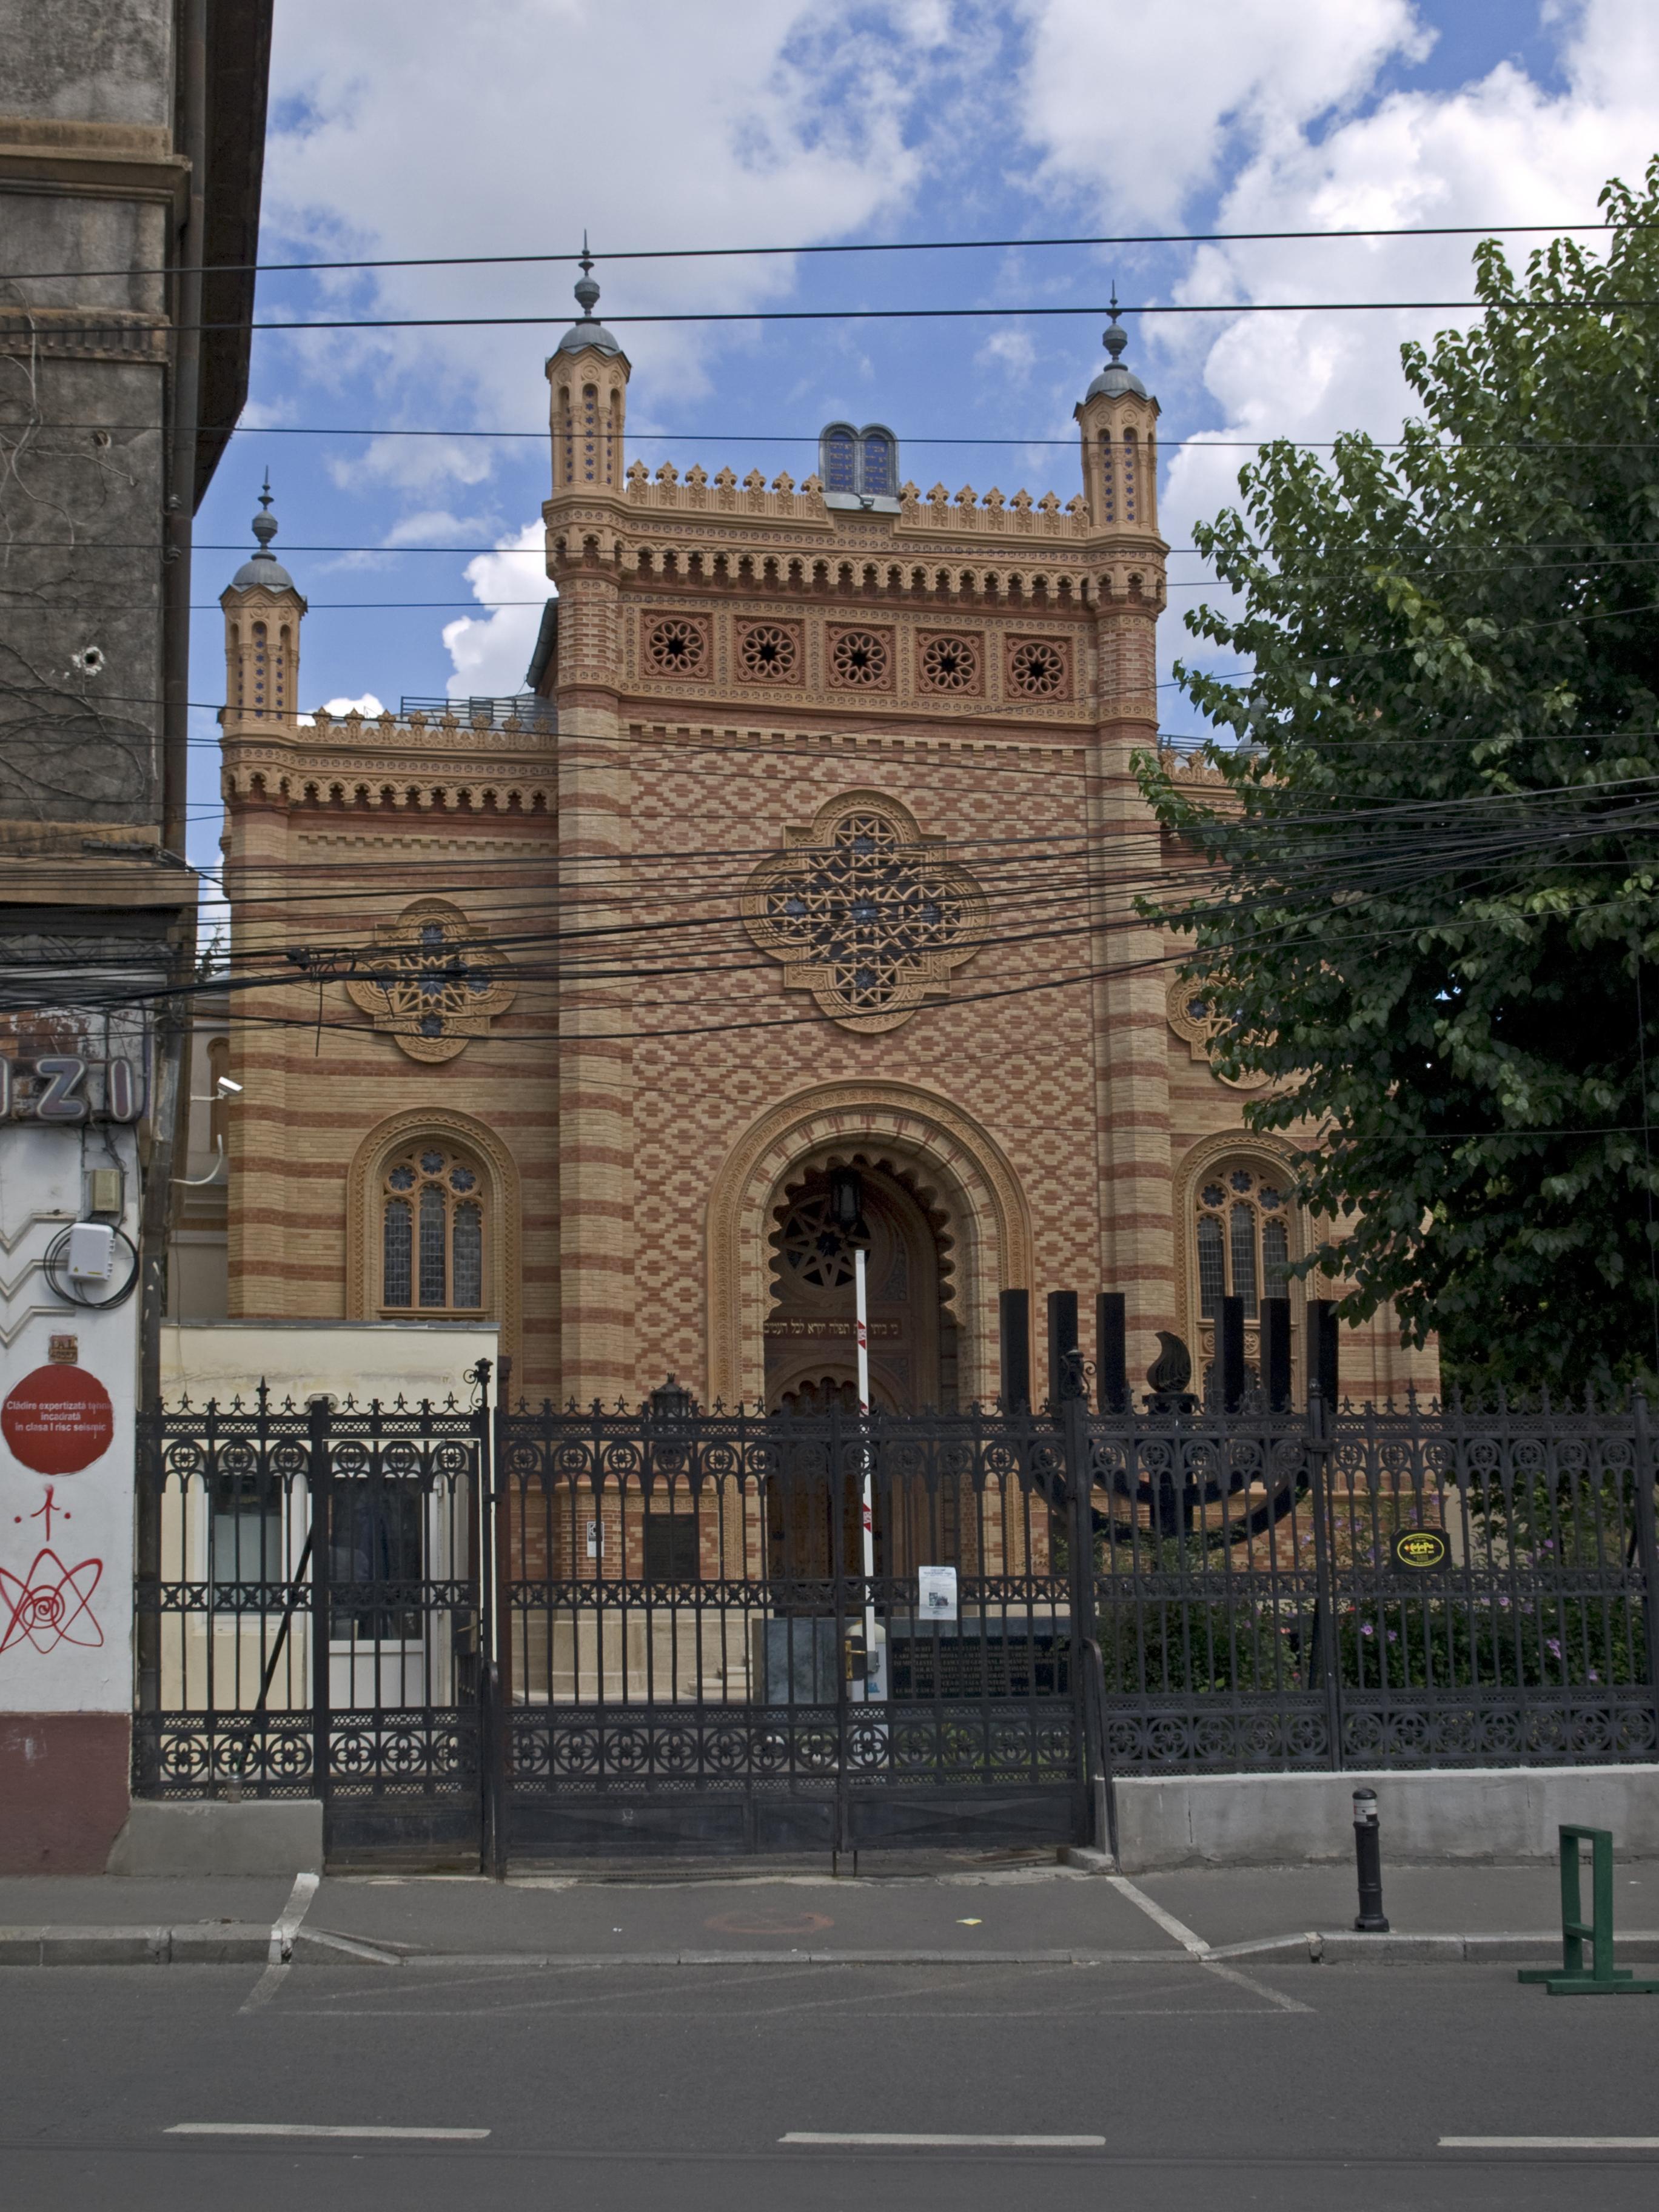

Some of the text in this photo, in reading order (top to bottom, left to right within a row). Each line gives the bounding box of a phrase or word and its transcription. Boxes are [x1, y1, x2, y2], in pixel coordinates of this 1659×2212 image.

[25, 1423, 48, 1431] clasa
[55, 1423, 72, 1431] risc
[73, 1423, 106, 1431] seismic
